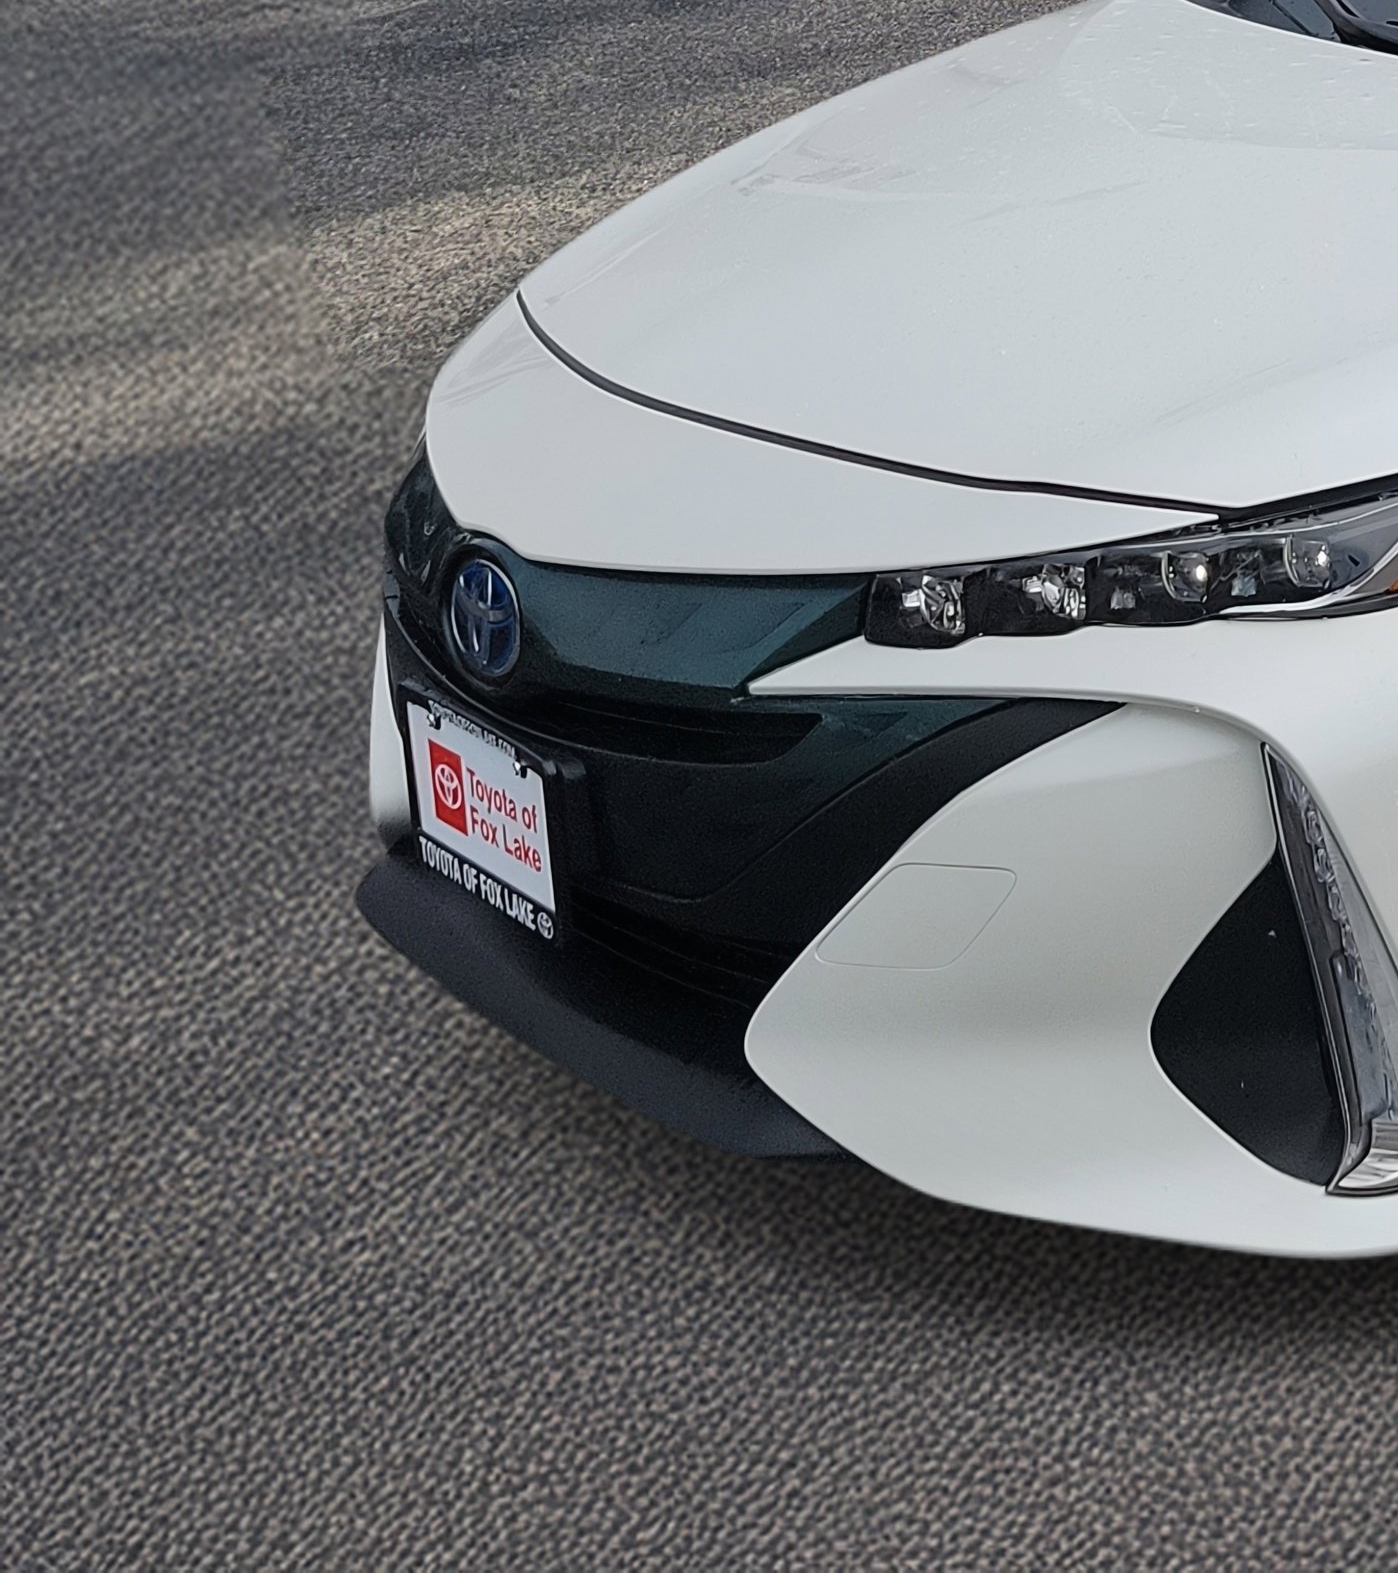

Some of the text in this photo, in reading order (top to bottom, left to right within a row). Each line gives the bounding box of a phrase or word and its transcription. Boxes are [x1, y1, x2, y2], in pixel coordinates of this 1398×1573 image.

[466, 767, 538, 834] Toyota of
[470, 805, 542, 873] Fox Lake
[419, 835, 536, 931] TOYOTA OF FOX LAKE
